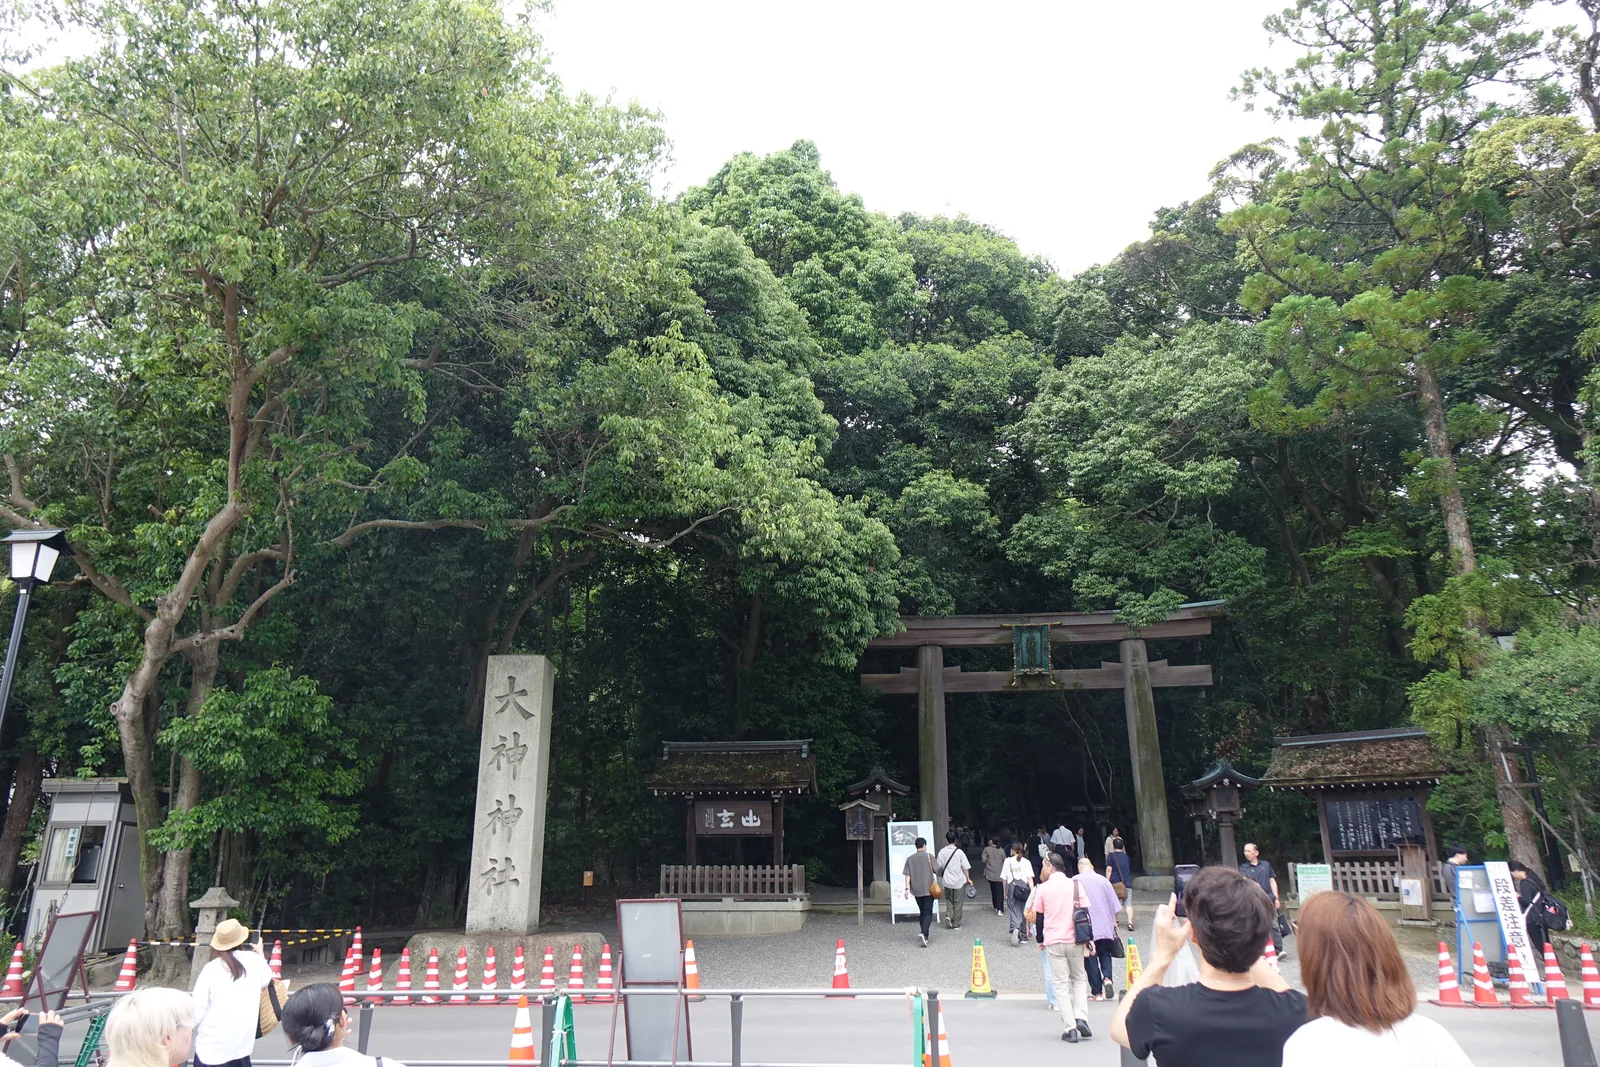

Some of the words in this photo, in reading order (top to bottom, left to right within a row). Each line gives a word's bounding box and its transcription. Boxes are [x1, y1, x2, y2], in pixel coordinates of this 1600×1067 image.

[479, 675, 536, 896] 大神神社
[1494, 878, 1527, 949] 段差注意
